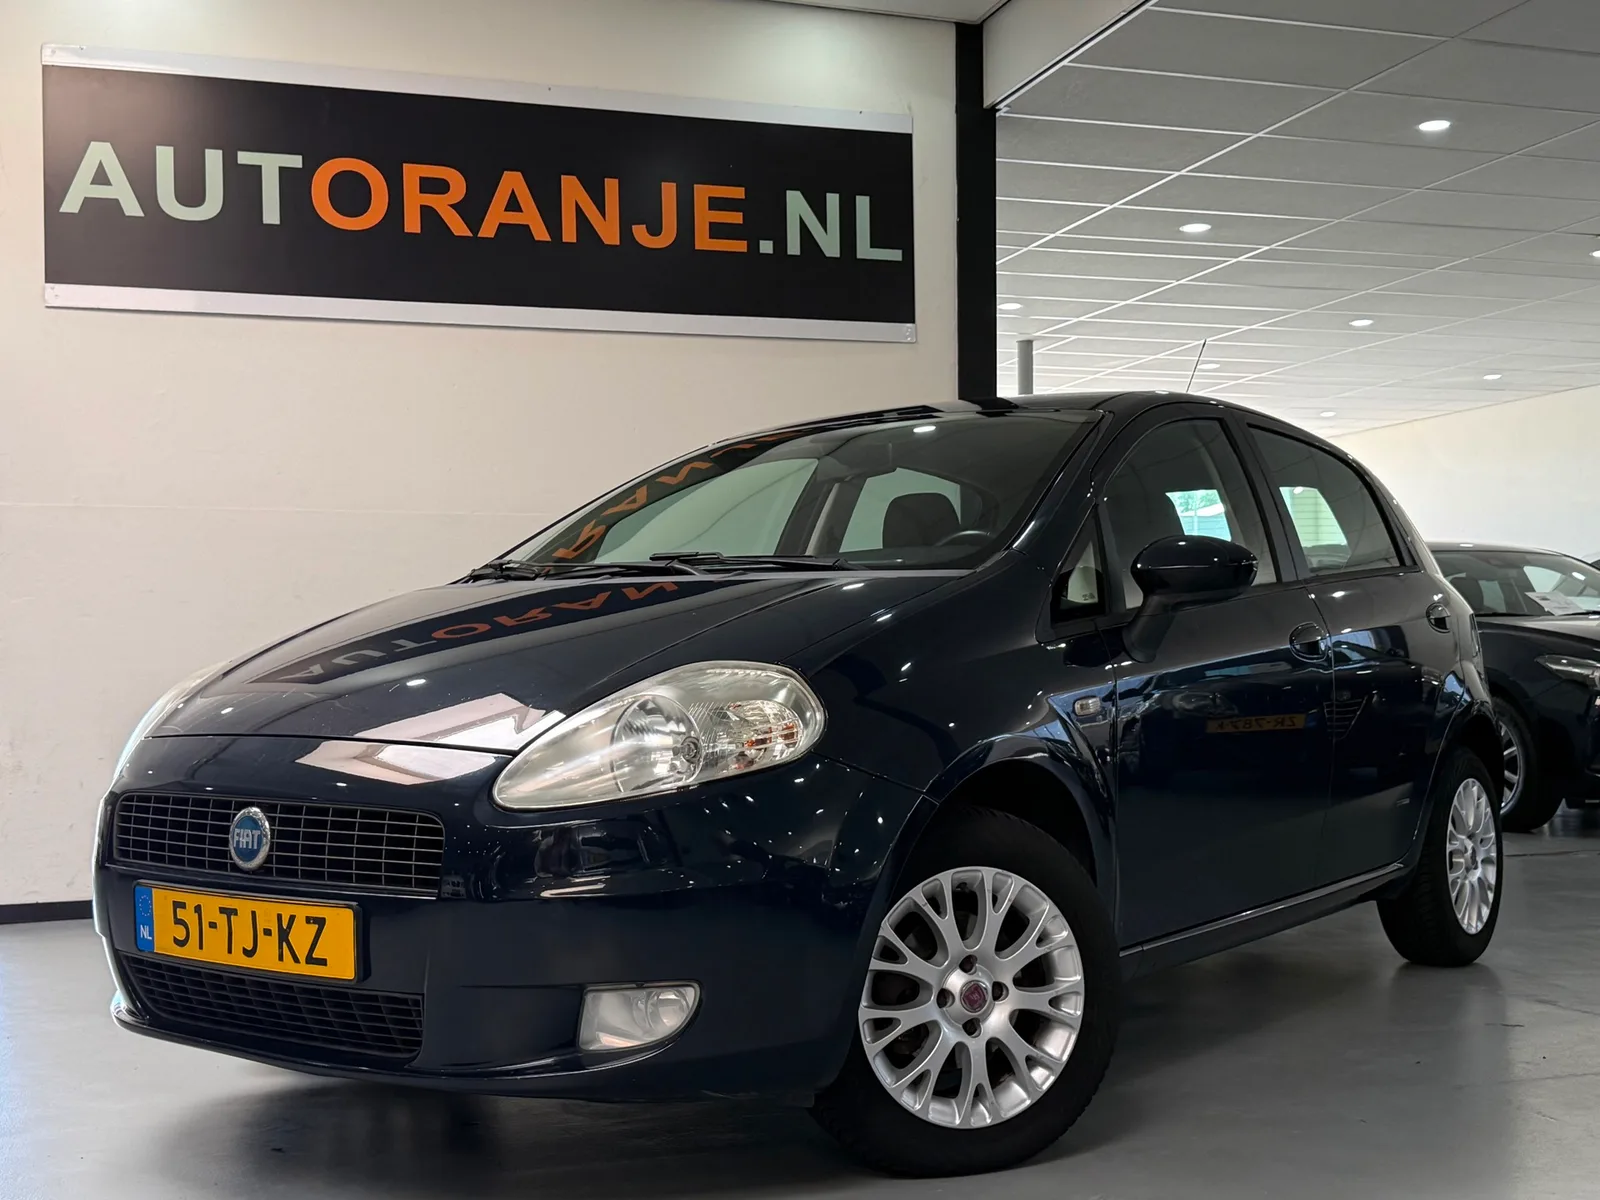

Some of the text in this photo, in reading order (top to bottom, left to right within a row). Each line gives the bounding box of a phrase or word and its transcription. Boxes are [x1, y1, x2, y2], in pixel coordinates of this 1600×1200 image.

[59, 140, 904, 262] AUTORANJE.NL
[233, 828, 261, 850] FIAT
[139, 924, 153, 941] NL
[171, 900, 328, 967] 51-TJ-KZ
